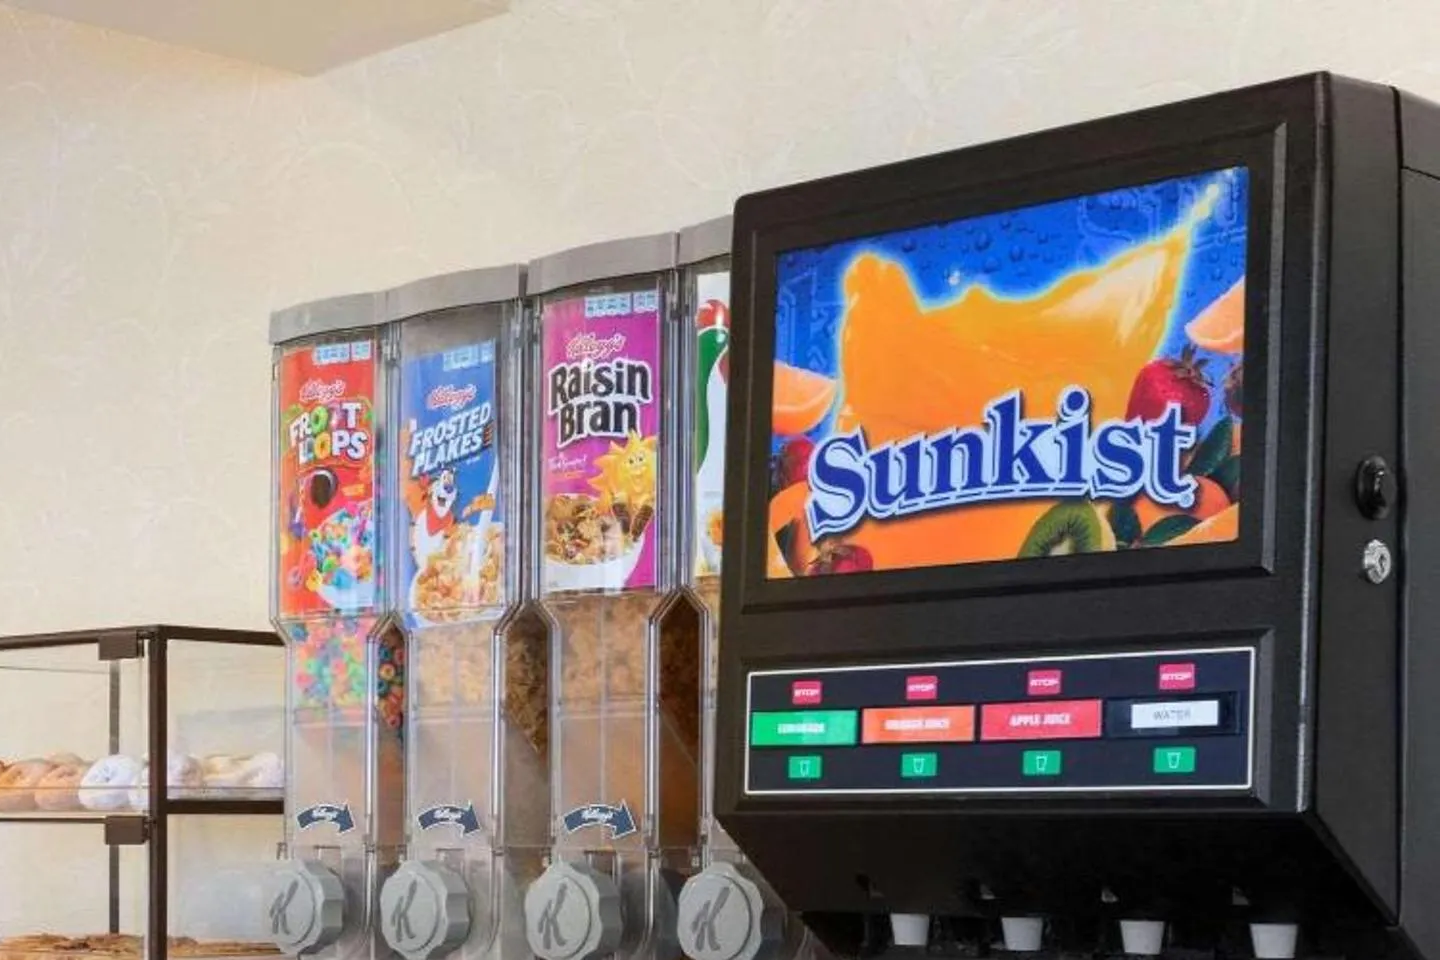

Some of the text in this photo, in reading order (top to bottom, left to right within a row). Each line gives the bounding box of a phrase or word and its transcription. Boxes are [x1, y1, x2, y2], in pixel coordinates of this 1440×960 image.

[549, 358, 651, 412] Raisin
[408, 402, 491, 456] FROSTED
[559, 399, 639, 446] Bran
[412, 427, 483, 476] FLAKES
[809, 386, 1197, 538] Sunkist
[1009, 714, 1040, 727] APPLE
[1152, 709, 1192, 722] WATER
